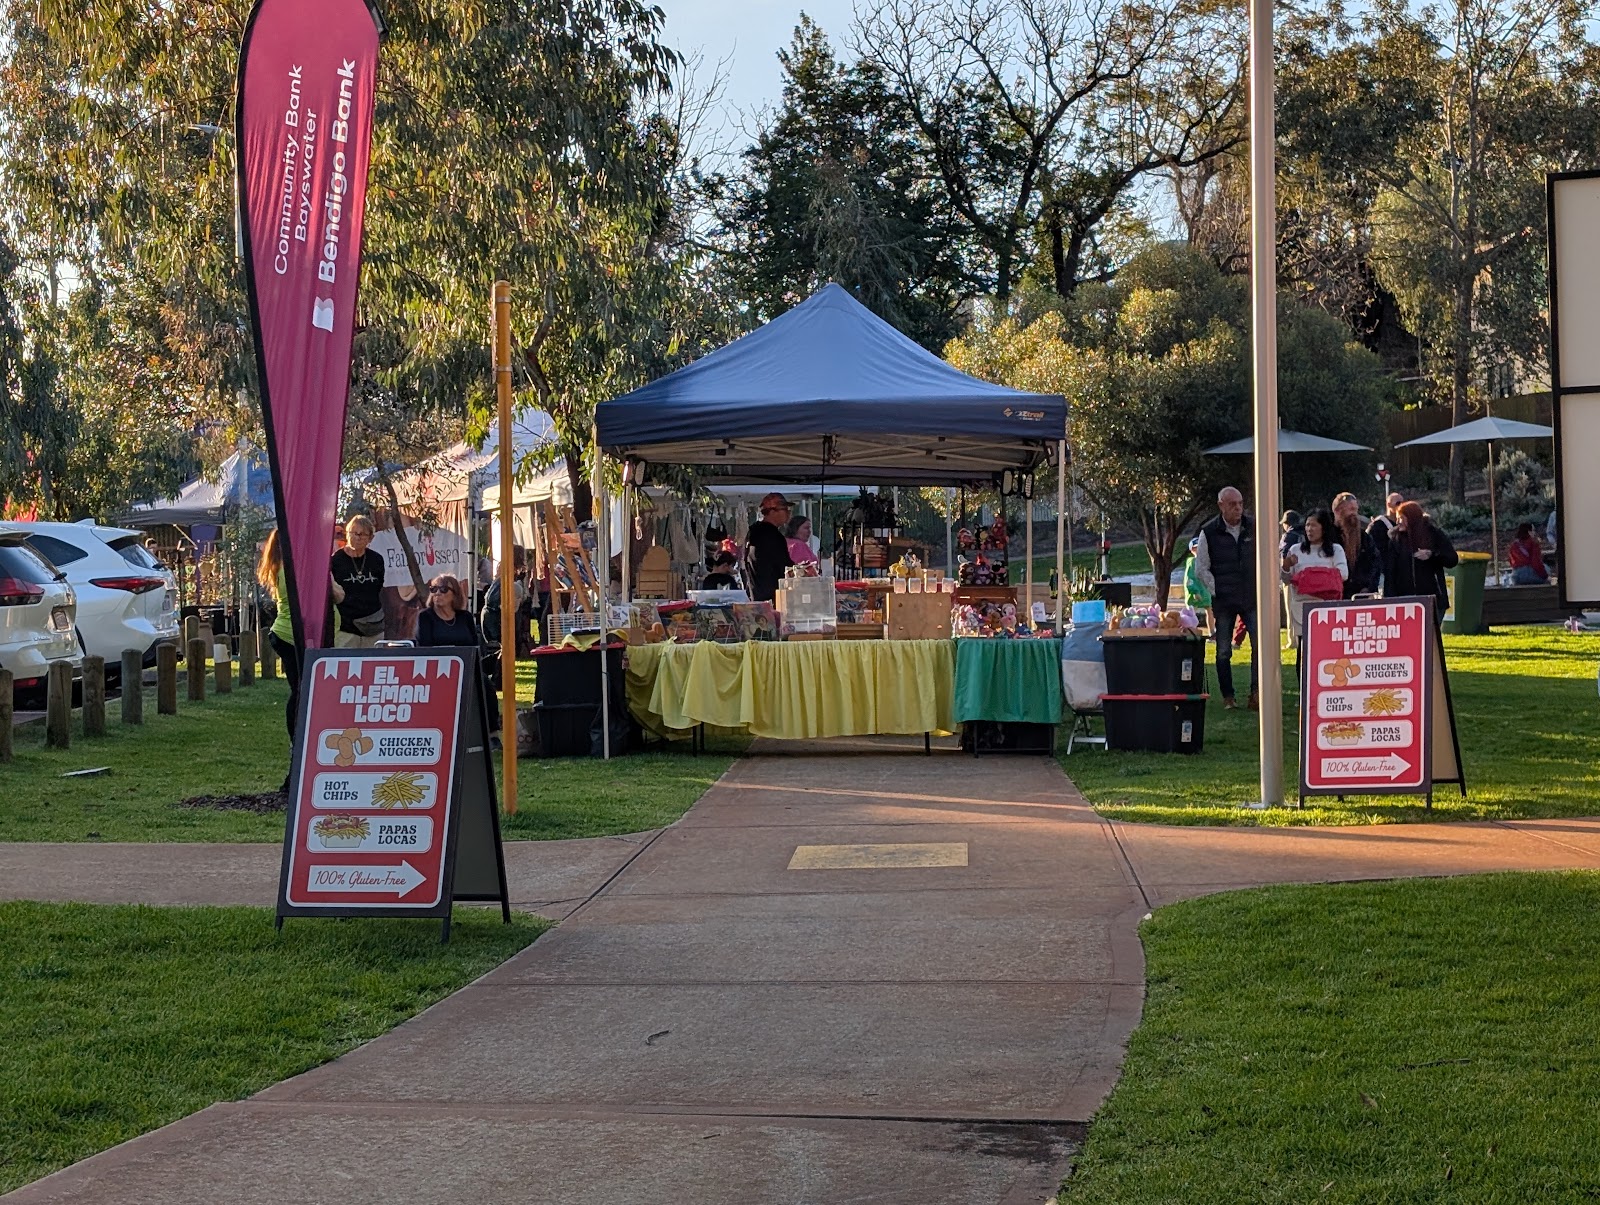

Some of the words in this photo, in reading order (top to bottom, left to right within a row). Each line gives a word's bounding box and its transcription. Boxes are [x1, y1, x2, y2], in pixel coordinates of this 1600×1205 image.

[285, 64, 303, 128] Bank
[331, 58, 356, 143] Bank
[295, 108, 318, 242] Bayswater
[274, 133, 300, 275] Community
[318, 151, 348, 283] Bendigo
[1356, 612, 1376, 626] EL
[1332, 625, 1400, 642] ALEMAN
[1344, 640, 1388, 655] LOCO
[1365, 663, 1405, 672] CHICKEN
[374, 666, 399, 685] EL
[1365, 670, 1408, 679] NUGGETS
[340, 684, 430, 704] ALEMAN
[1326, 697, 1345, 705] HOT
[354, 704, 412, 723] LOCO
[1326, 704, 1353, 712] CHIPS
[1371, 727, 1400, 735] PAPAS
[379, 737, 433, 747] CHICKEN
[1371, 734, 1401, 743] LOCAS
[378, 747, 435, 757] NUGGETS
[1326, 762, 1350, 773] 100%
[1351, 760, 1396, 773] Gluten-Free
[324, 781, 349, 790] HOT
[323, 791, 359, 801] CHIPS
[379, 825, 417, 835] PAPAS
[378, 835, 417, 845] LOCAS
[315, 870, 346, 885] 100%
[348, 870, 406, 888] Gluten-Free
